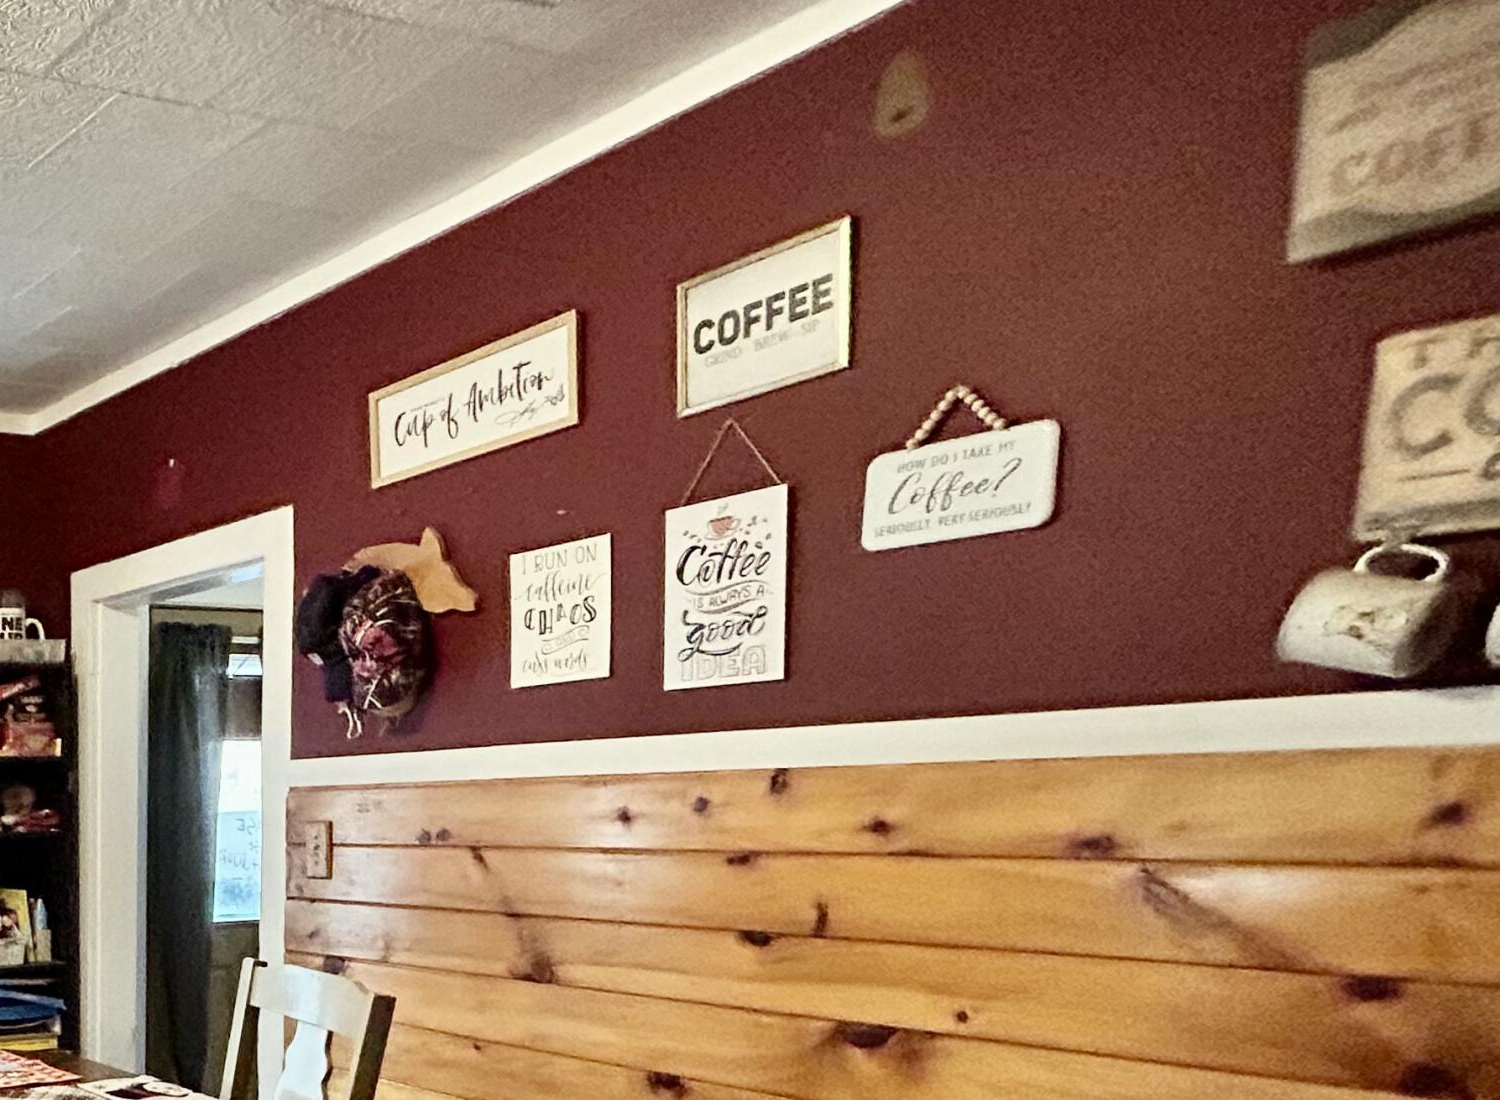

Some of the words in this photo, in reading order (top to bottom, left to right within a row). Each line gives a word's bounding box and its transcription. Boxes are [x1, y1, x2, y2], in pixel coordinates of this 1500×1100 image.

[693, 272, 834, 355] COFFEE
[395, 408, 436, 448] Cup
[439, 393, 459, 439] of
[463, 361, 554, 423] Ambition
[897, 458, 927, 473] HOW
[962, 444, 994, 461] TAKE
[998, 440, 1017, 453] MY
[888, 457, 1022, 515] Coffee?
[938, 513, 966, 527] VERY
[968, 501, 1033, 522] SERIOUSLY
[521, 554, 526, 576] I
[533, 549, 568, 573] RUN
[575, 543, 598, 564] ON
[676, 537, 772, 587] Coffee
[524, 595, 597, 636] CHAOS
[692, 597, 704, 609] IS
[709, 584, 752, 608] ALWAYS
[756, 584, 766, 597] A
[677, 604, 769, 663] good
[681, 644, 766, 682] IDEA
